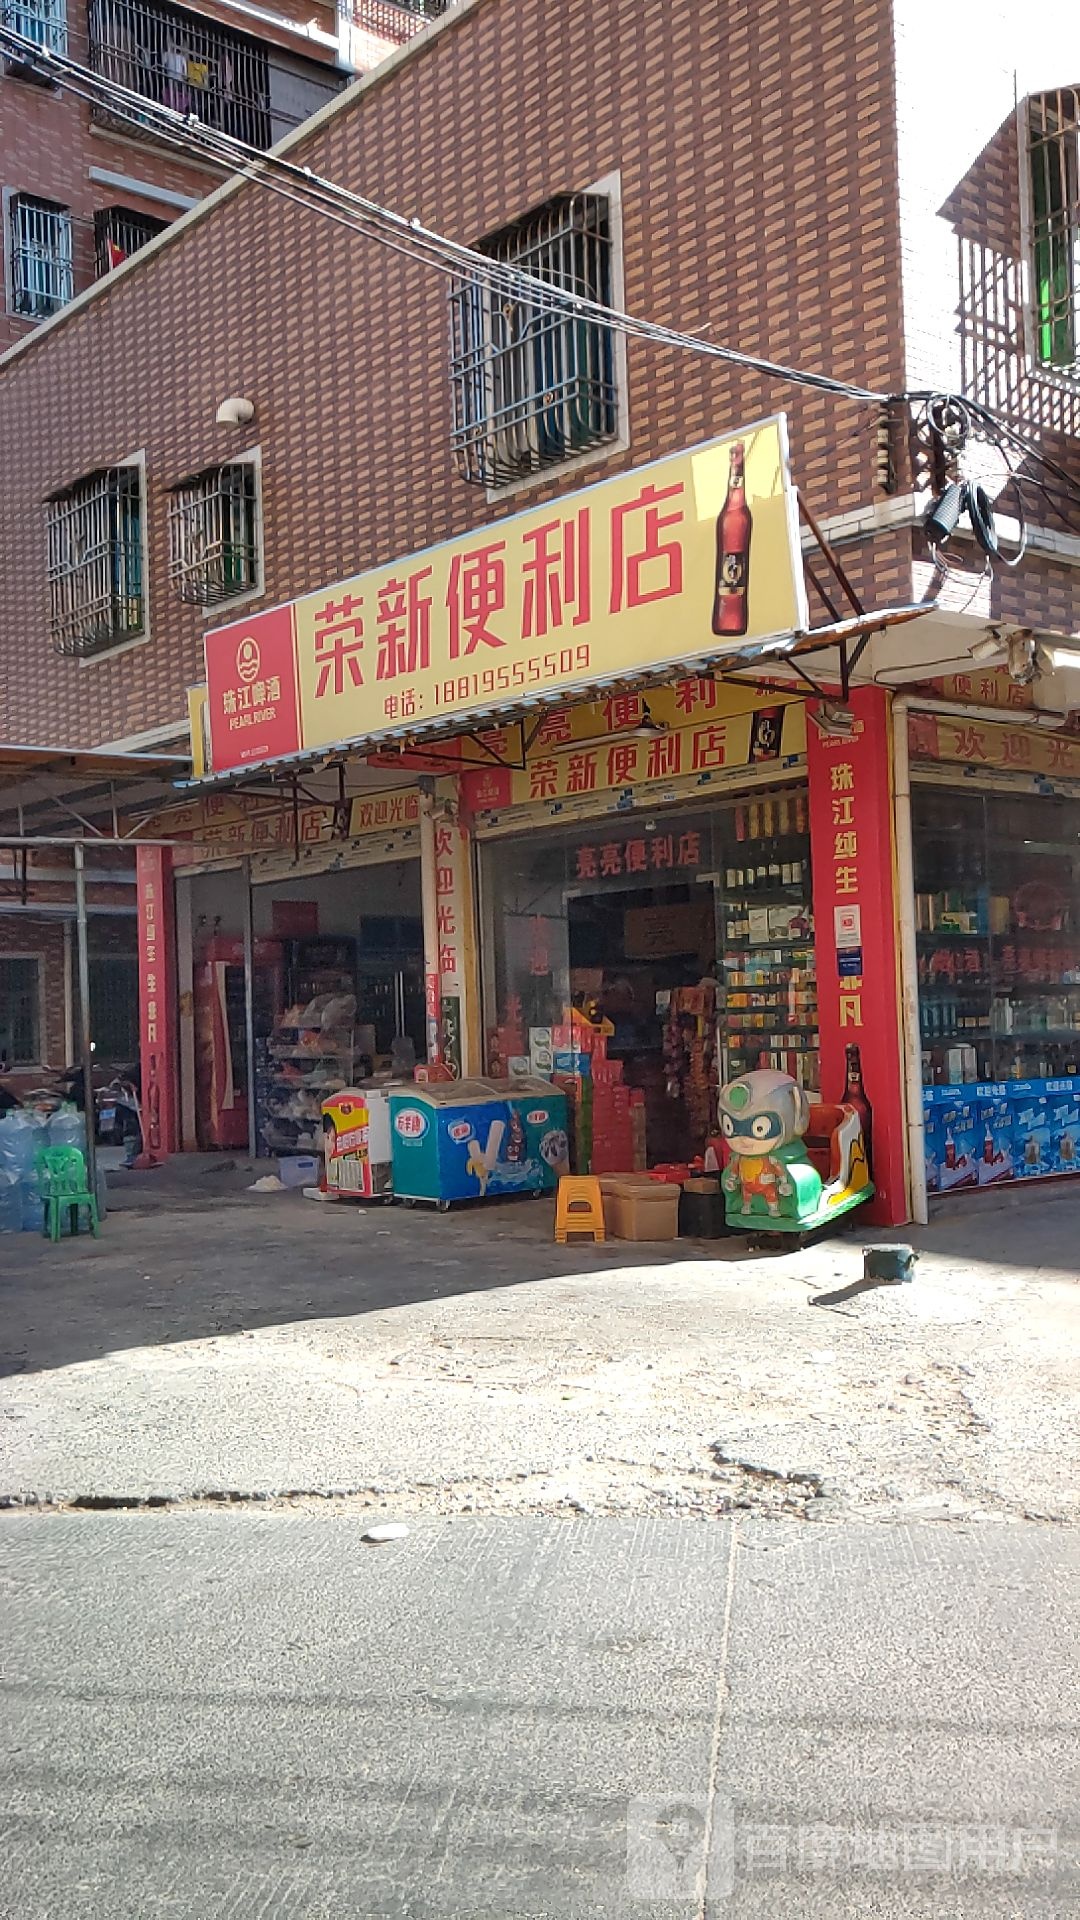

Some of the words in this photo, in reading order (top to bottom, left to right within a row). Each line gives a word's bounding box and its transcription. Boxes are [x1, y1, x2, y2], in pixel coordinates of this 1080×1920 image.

[314, 481, 685, 699] 荣新便利店
[529, 725, 727, 800] 荣新便利店
[359, 795, 419, 828] 欢迎光临
[830, 763, 859, 894] 珠江纯生
[576, 831, 701, 880] 亮亮便利店
